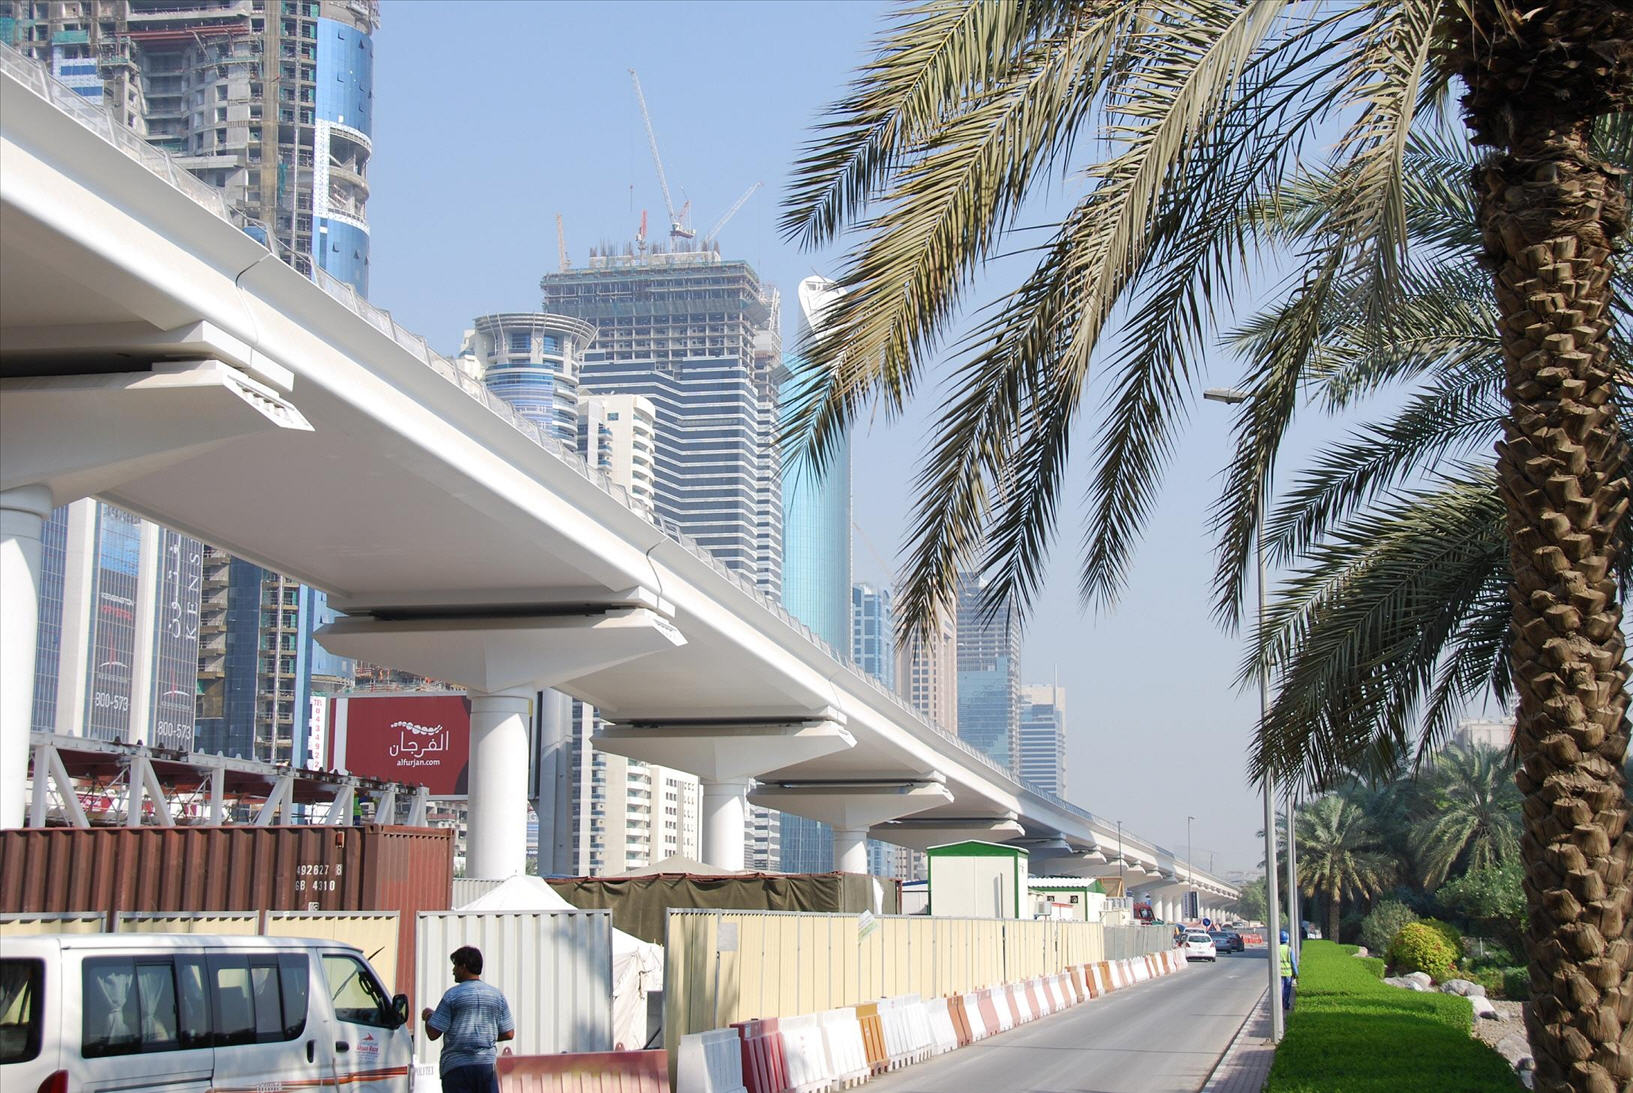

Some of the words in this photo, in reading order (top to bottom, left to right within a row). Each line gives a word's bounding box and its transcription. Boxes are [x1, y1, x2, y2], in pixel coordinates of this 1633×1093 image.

[95, 692, 129, 711] 800-573
[158, 721, 192, 740] 800-573
[390, 730, 449, 758] الفرجان
[396, 758, 441, 768] alfurjan.com
[312, 880, 336, 891] 4310
